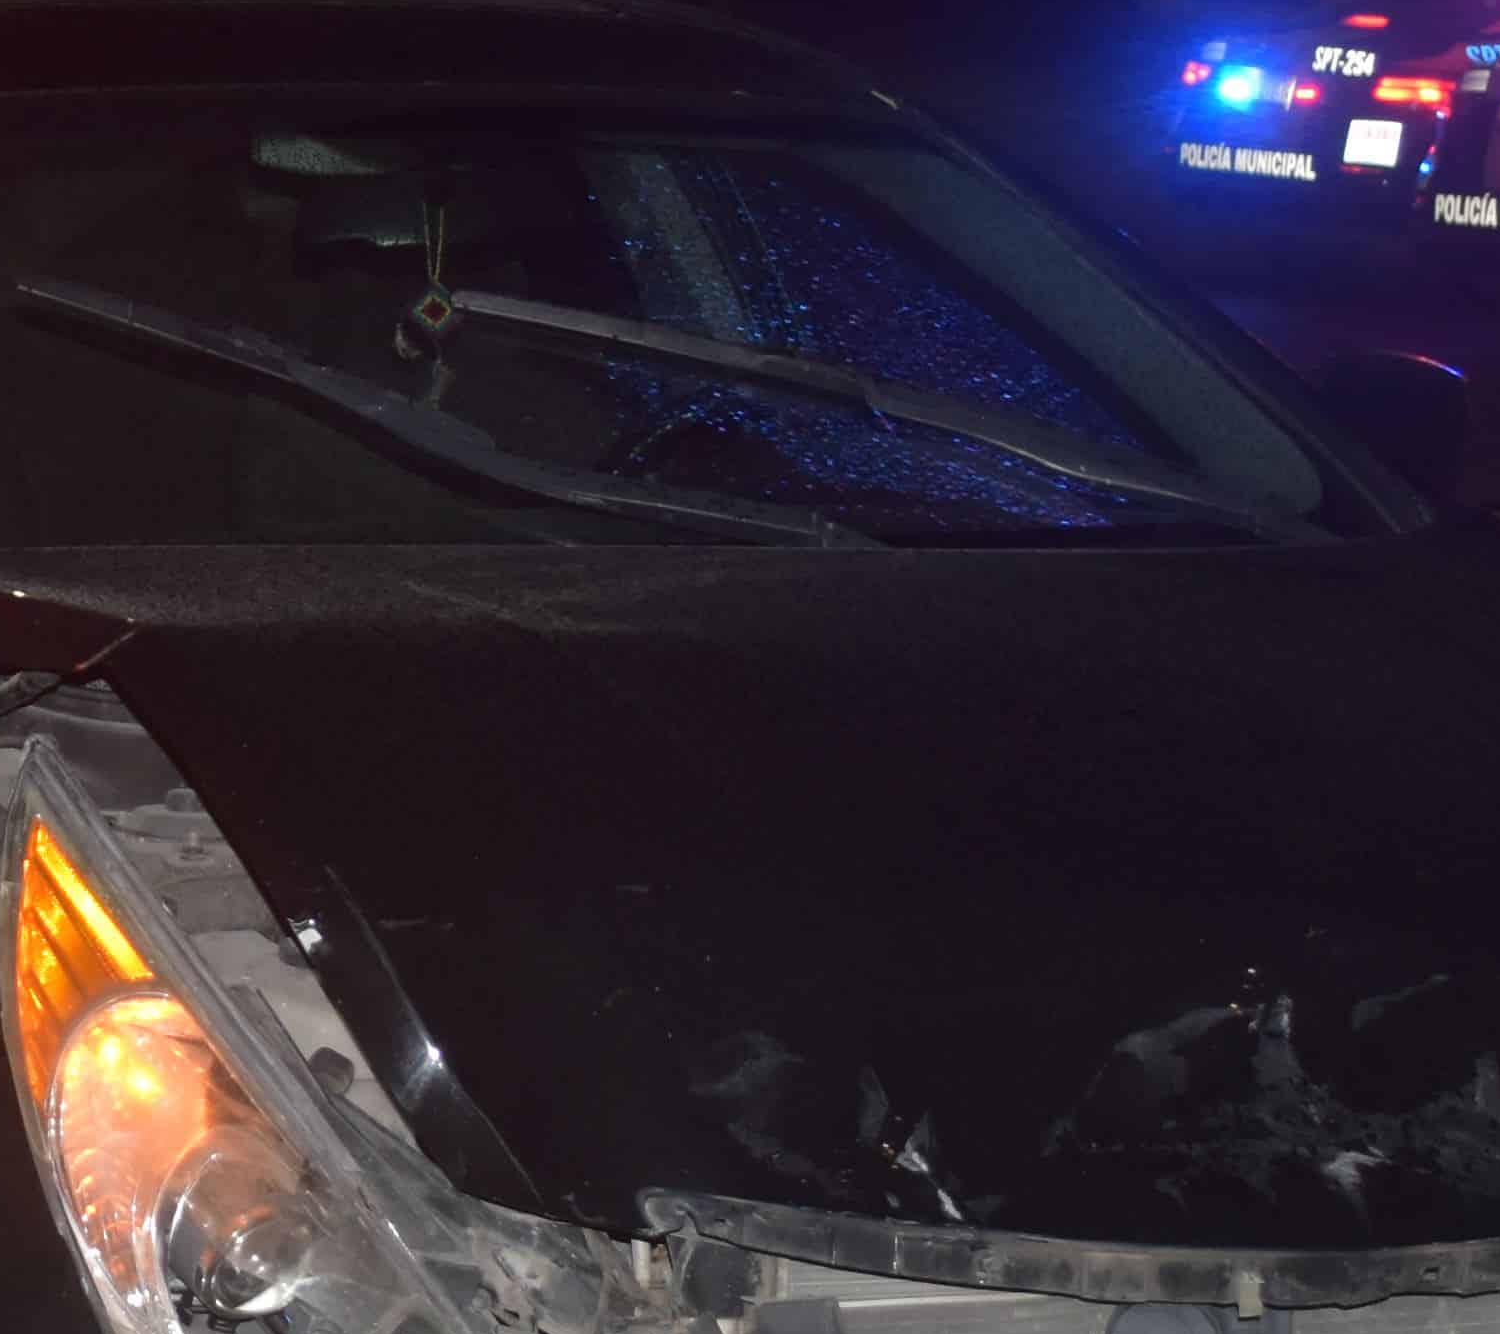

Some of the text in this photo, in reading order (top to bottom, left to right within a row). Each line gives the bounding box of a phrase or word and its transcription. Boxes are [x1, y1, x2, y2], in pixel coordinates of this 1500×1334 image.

[1312, 46, 1375, 77] SPT-254
[1180, 142, 1316, 181] POLICÍA MUNICIPAL
[1434, 192, 1497, 228] POLICÍA
